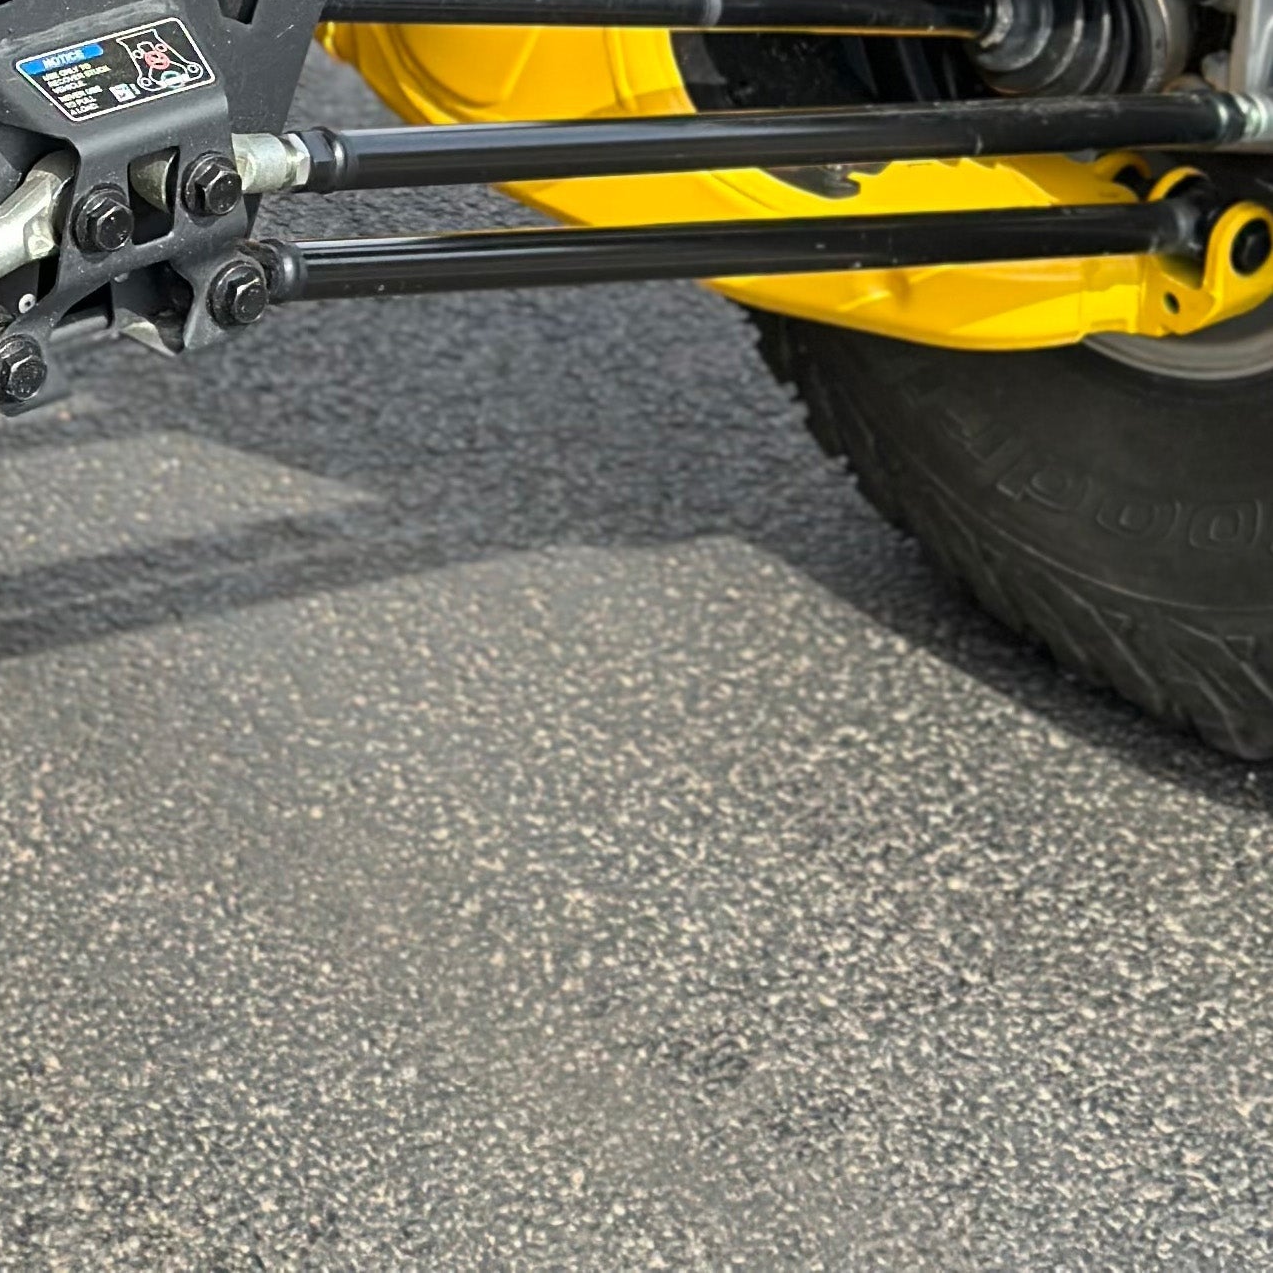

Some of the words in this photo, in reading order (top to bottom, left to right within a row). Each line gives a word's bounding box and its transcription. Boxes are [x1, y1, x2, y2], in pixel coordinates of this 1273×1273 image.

[42, 49, 84, 68] NOTICE
[47, 72, 85, 88] RECOVER
[84, 65, 112, 77] STUCK
[59, 66, 78, 77] ONLY
[79, 63, 91, 71] TO
[75, 96, 97, 106] PULL
